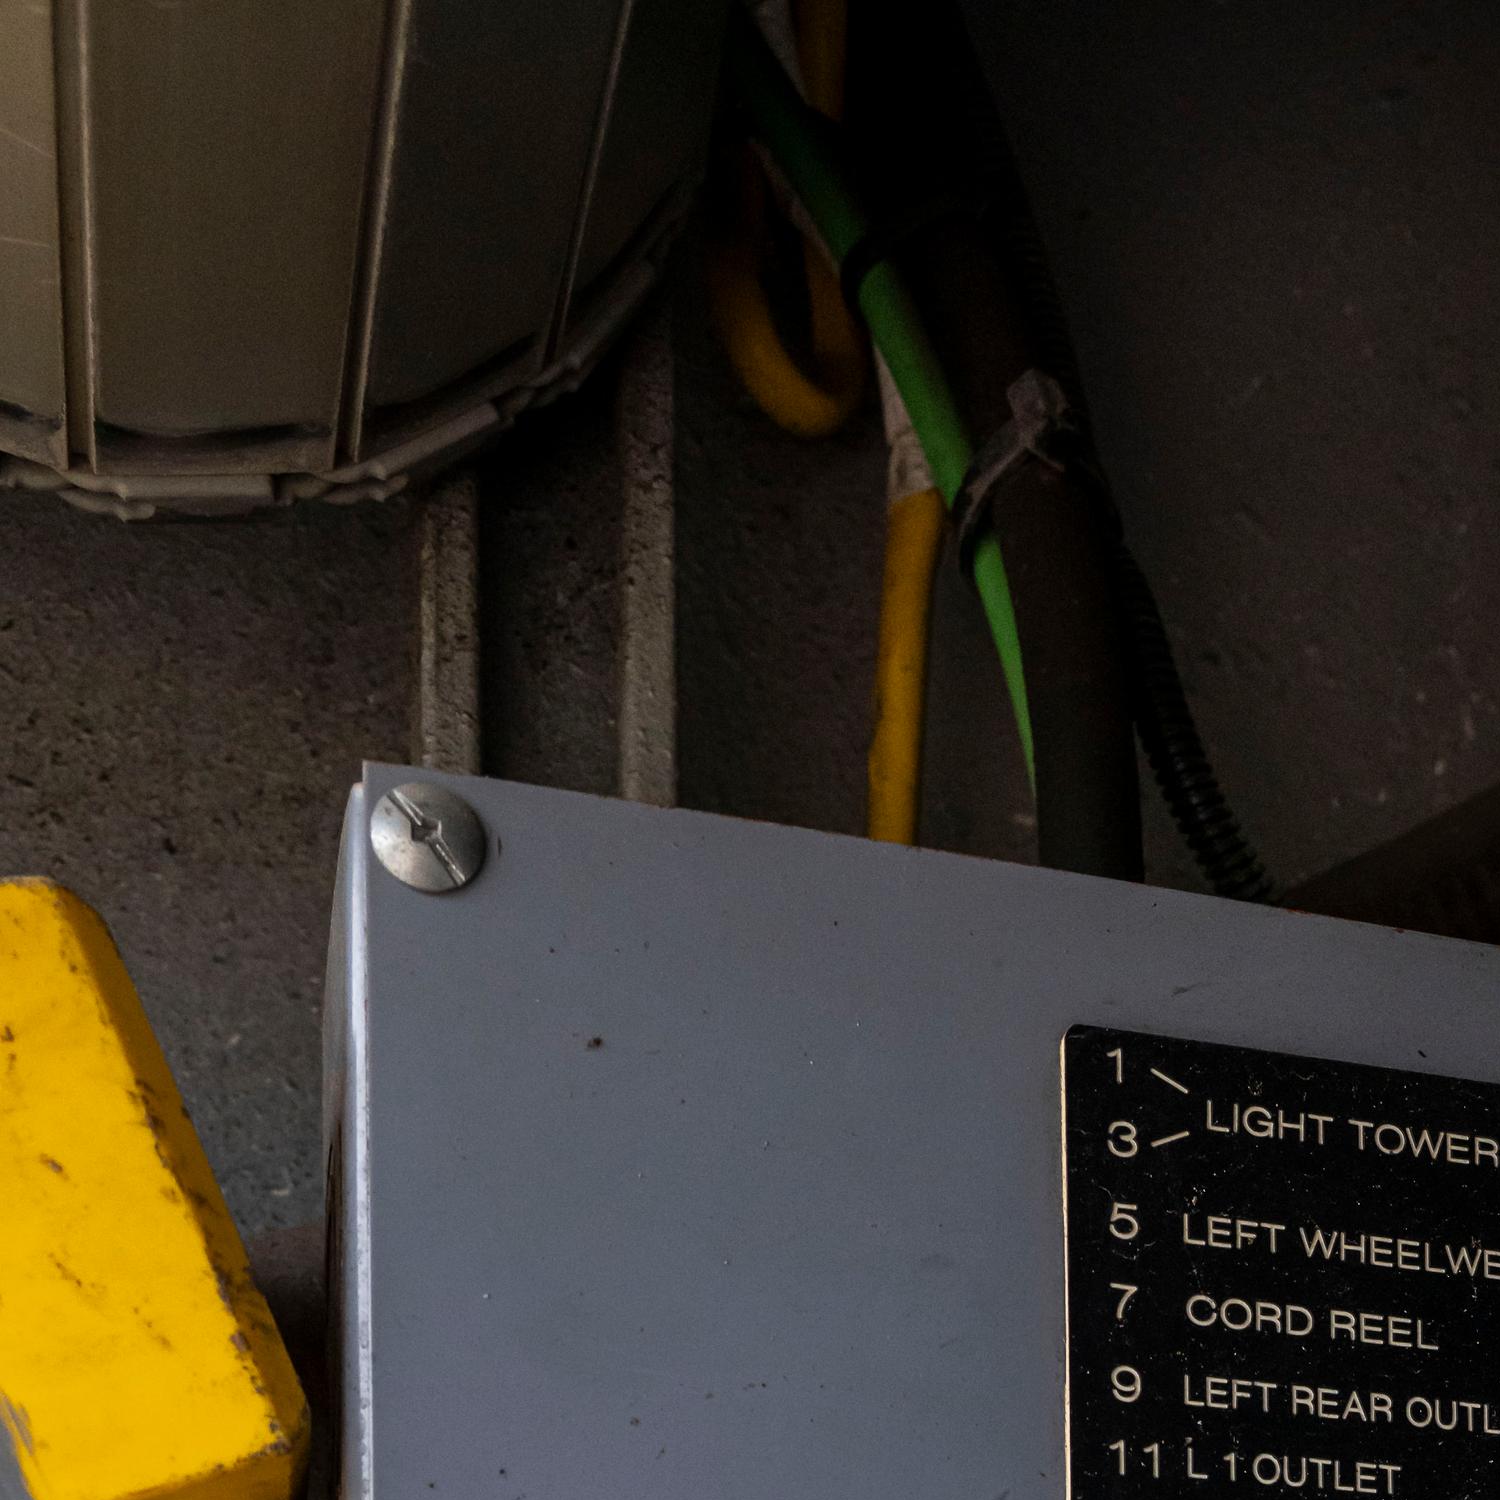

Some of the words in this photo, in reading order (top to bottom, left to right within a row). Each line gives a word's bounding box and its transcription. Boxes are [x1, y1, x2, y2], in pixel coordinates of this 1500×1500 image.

[1107, 1048, 1123, 1084] 1
[1107, 1120, 1138, 1158] 3
[1206, 1099, 1334, 1145] LIGHT
[1348, 1119, 1499, 1168] TOWER
[1109, 1202, 1139, 1240] 5
[1183, 1212, 1286, 1253] LEFT
[1110, 1282, 1138, 1319] 7
[1186, 1294, 1313, 1336] CORD
[1330, 1309, 1439, 1351] REEL
[1111, 1365, 1142, 1403] 9
[1184, 1374, 1278, 1413] LEFT
[1292, 1385, 1393, 1422] REAR
[1109, 1439, 1159, 1478] 11
[1253, 1453, 1402, 1495] OUTLET
